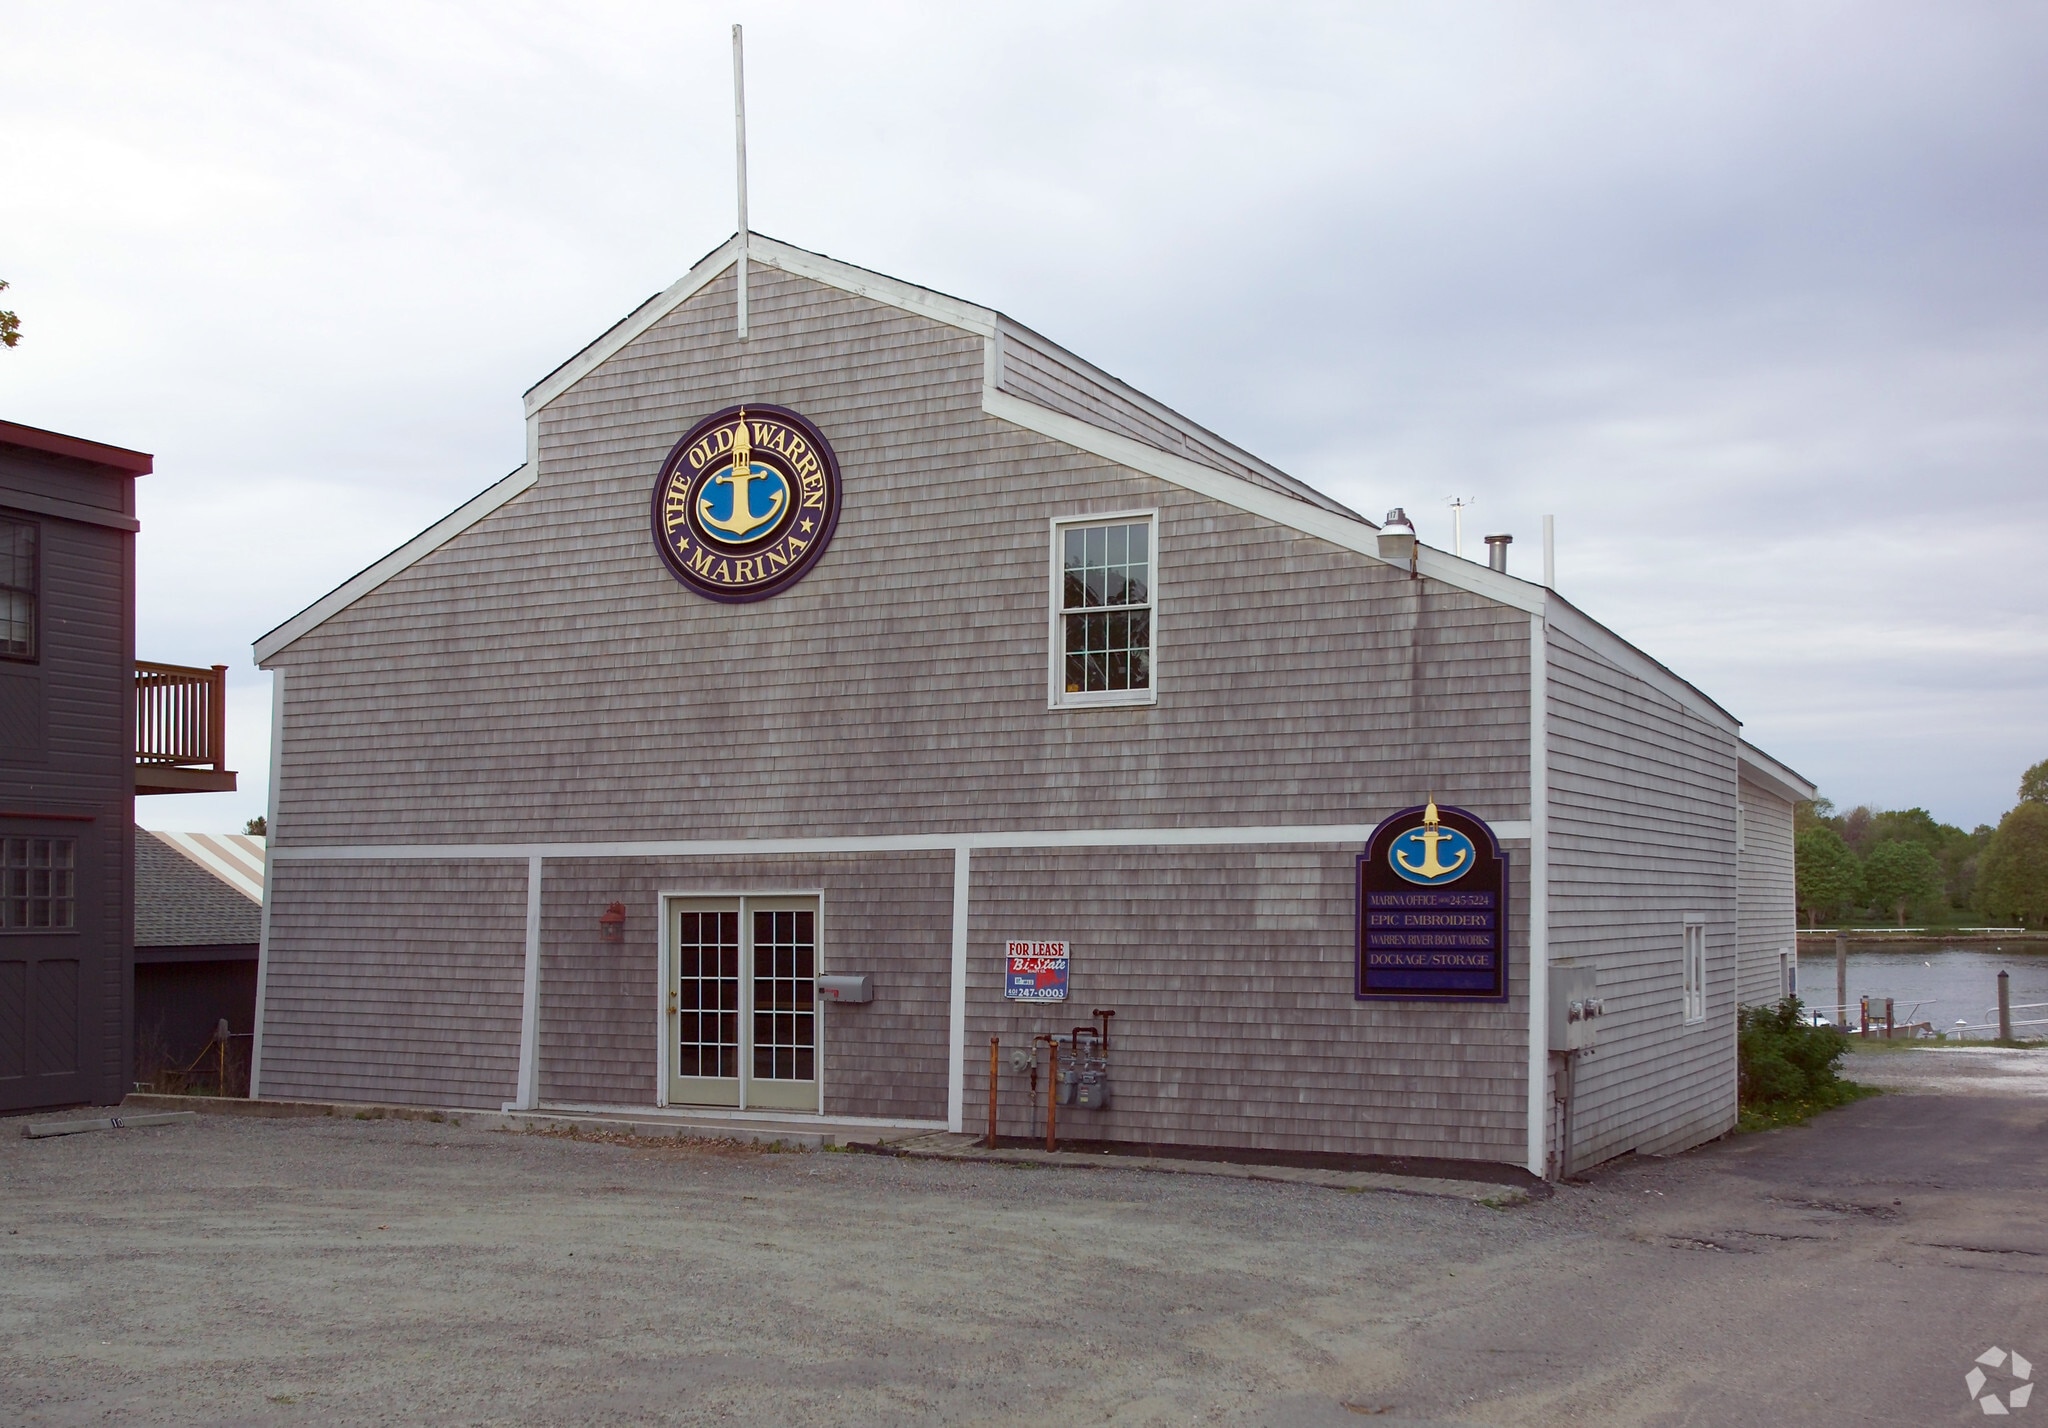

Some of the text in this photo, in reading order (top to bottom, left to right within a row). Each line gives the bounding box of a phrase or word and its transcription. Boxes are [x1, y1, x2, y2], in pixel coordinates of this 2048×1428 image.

[665, 422, 825, 535] THE OLD WARREN
[686, 535, 809, 584] MARINA
[1370, 895, 1405, 906] MARINA
[1406, 895, 1438, 906] OFFICE
[1370, 914, 1489, 926] EPIC EMBROIDERY
[1370, 934, 1490, 946] WARREN RIVER BOAT WORKS
[1008, 942, 1065, 957] FOR LEASE
[1013, 958, 1066, 971] Bi-State
[1018, 988, 1064, 998] 247-0003
[112, 1118, 124, 1128] 10
